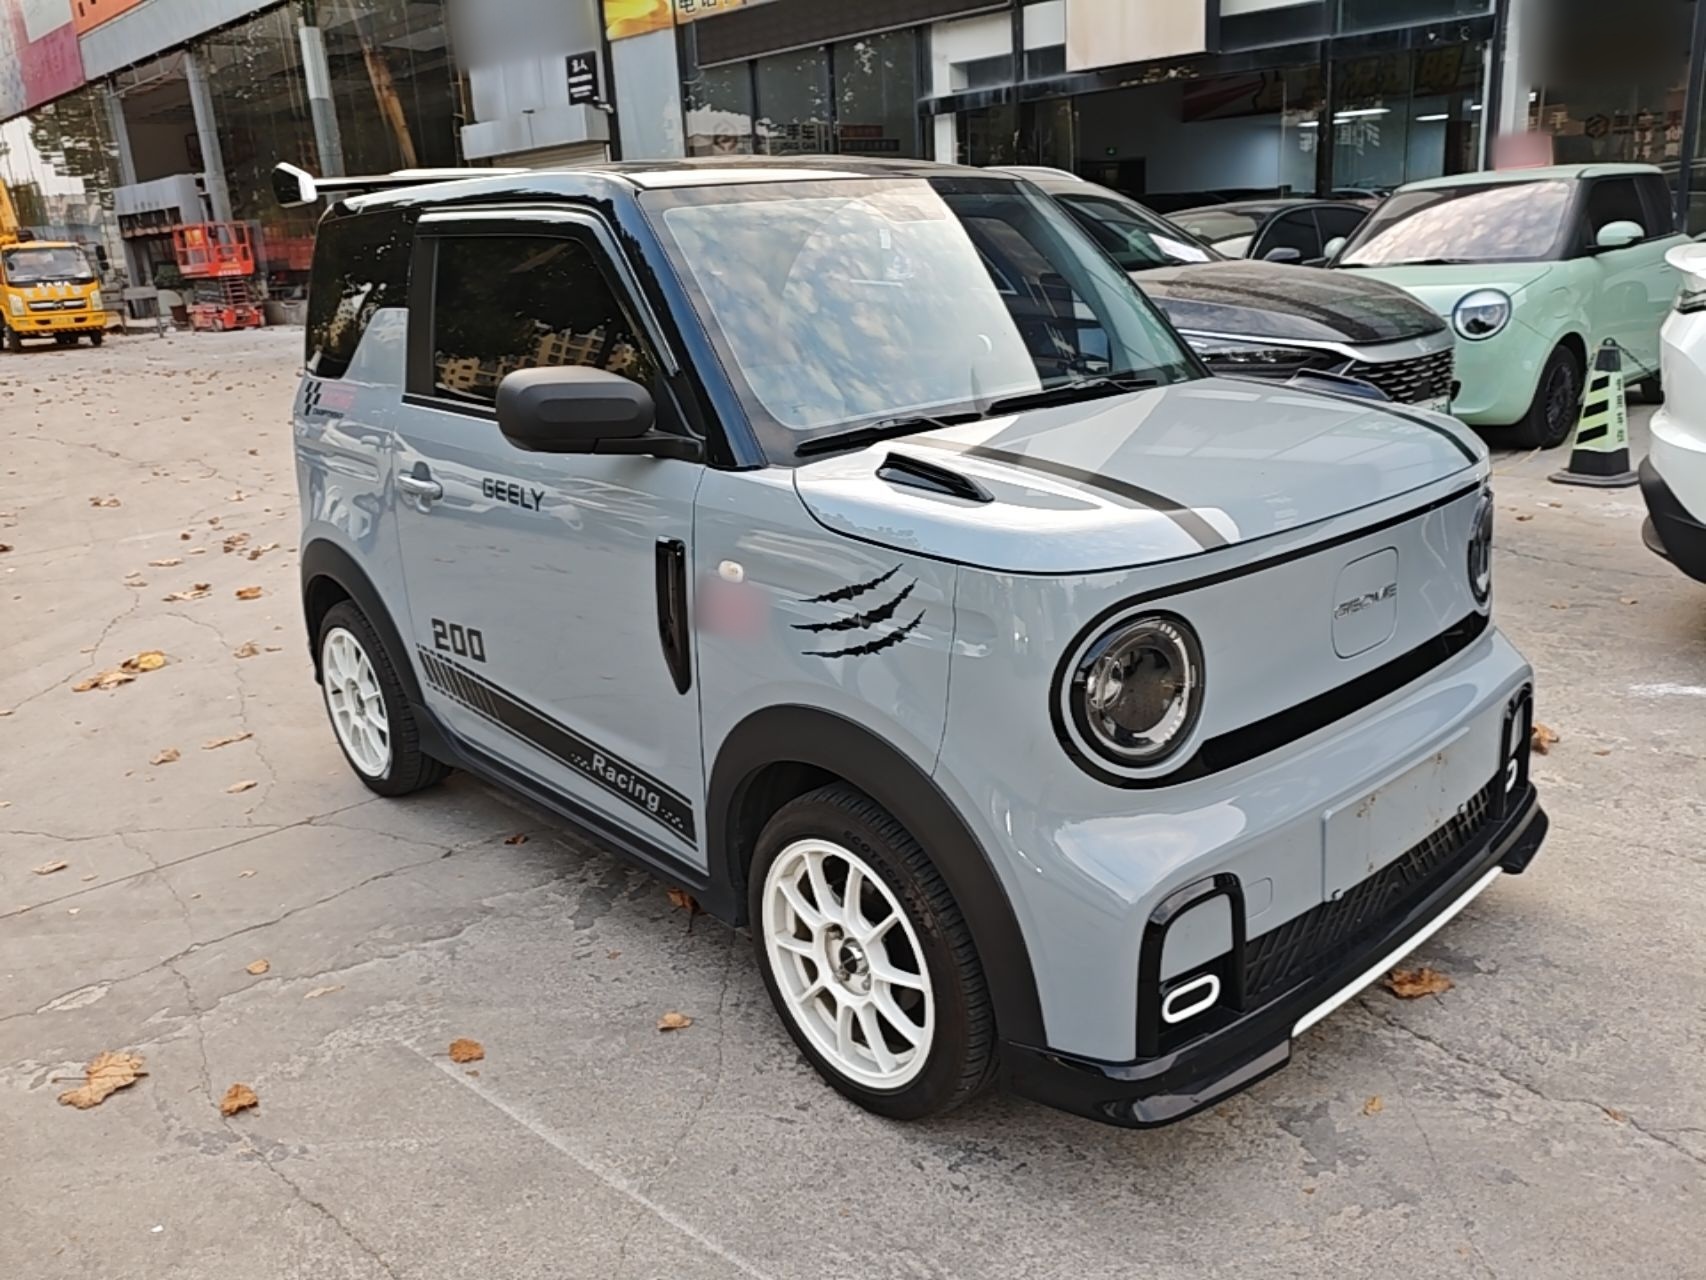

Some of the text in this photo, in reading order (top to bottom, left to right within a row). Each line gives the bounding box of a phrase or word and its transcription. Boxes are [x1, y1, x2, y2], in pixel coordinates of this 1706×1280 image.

[483, 477, 545, 512] GEELY
[431, 617, 487, 663] 200
[592, 753, 661, 812] Racing
